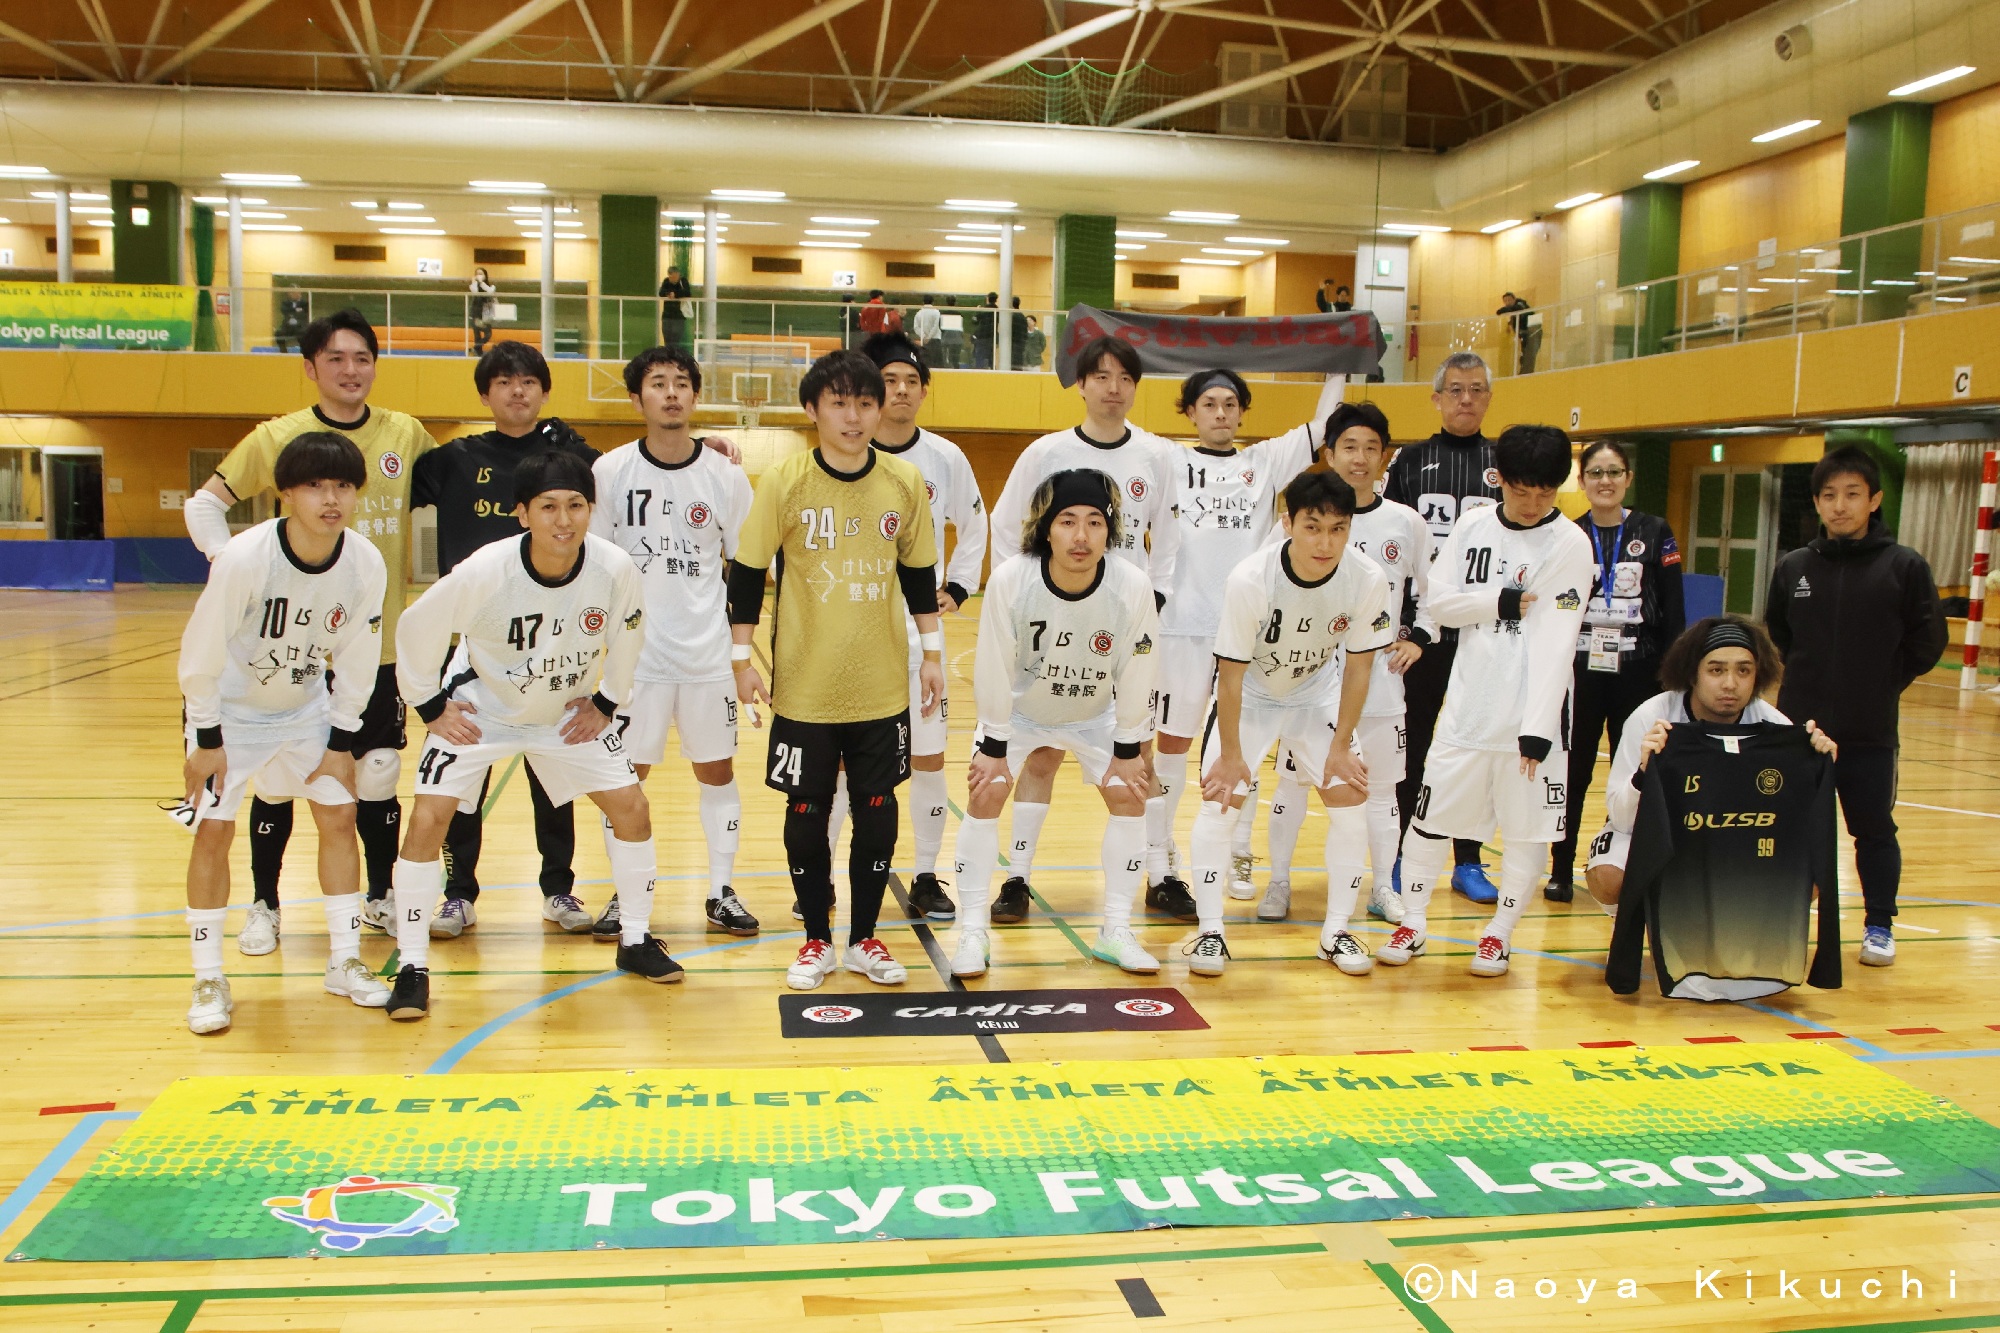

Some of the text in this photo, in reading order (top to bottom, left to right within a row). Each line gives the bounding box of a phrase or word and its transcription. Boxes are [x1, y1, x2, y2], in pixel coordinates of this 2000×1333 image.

[0, 288, 31, 296] HLETA
[0, 322, 170, 344] okyo Futsal League
[1067, 314, 1375, 356] Activital
[1955, 372, 1968, 392] C
[1187, 463, 1206, 489] 11
[626, 489, 652, 527] 17
[801, 506, 837, 550] 24
[1465, 547, 1492, 584] 20
[260, 598, 288, 639] 10
[507, 612, 543, 651] 47
[1264, 608, 1283, 644] 8
[1029, 620, 1047, 652] 7
[1047, 664, 1107, 681] けいじゅ
[1051, 682, 1097, 697] 整骨院
[615, 714, 631, 741] 7
[418, 747, 457, 785] 47
[770, 742, 803, 786] 24
[1705, 812, 1776, 829] LZSB
[1757, 837, 1775, 857] 99
[895, 1003, 1087, 1018] CAMISA
[976, 1020, 1020, 1030] KEIJU
[209, 1094, 524, 1116] ATHLETA
[575, 1088, 880, 1112] ATHLETA
[928, 1078, 1215, 1103] ATHLETA
[1261, 1068, 1534, 1094] ATHLETA
[559, 1150, 1905, 1235] Tokyo Futsal League
